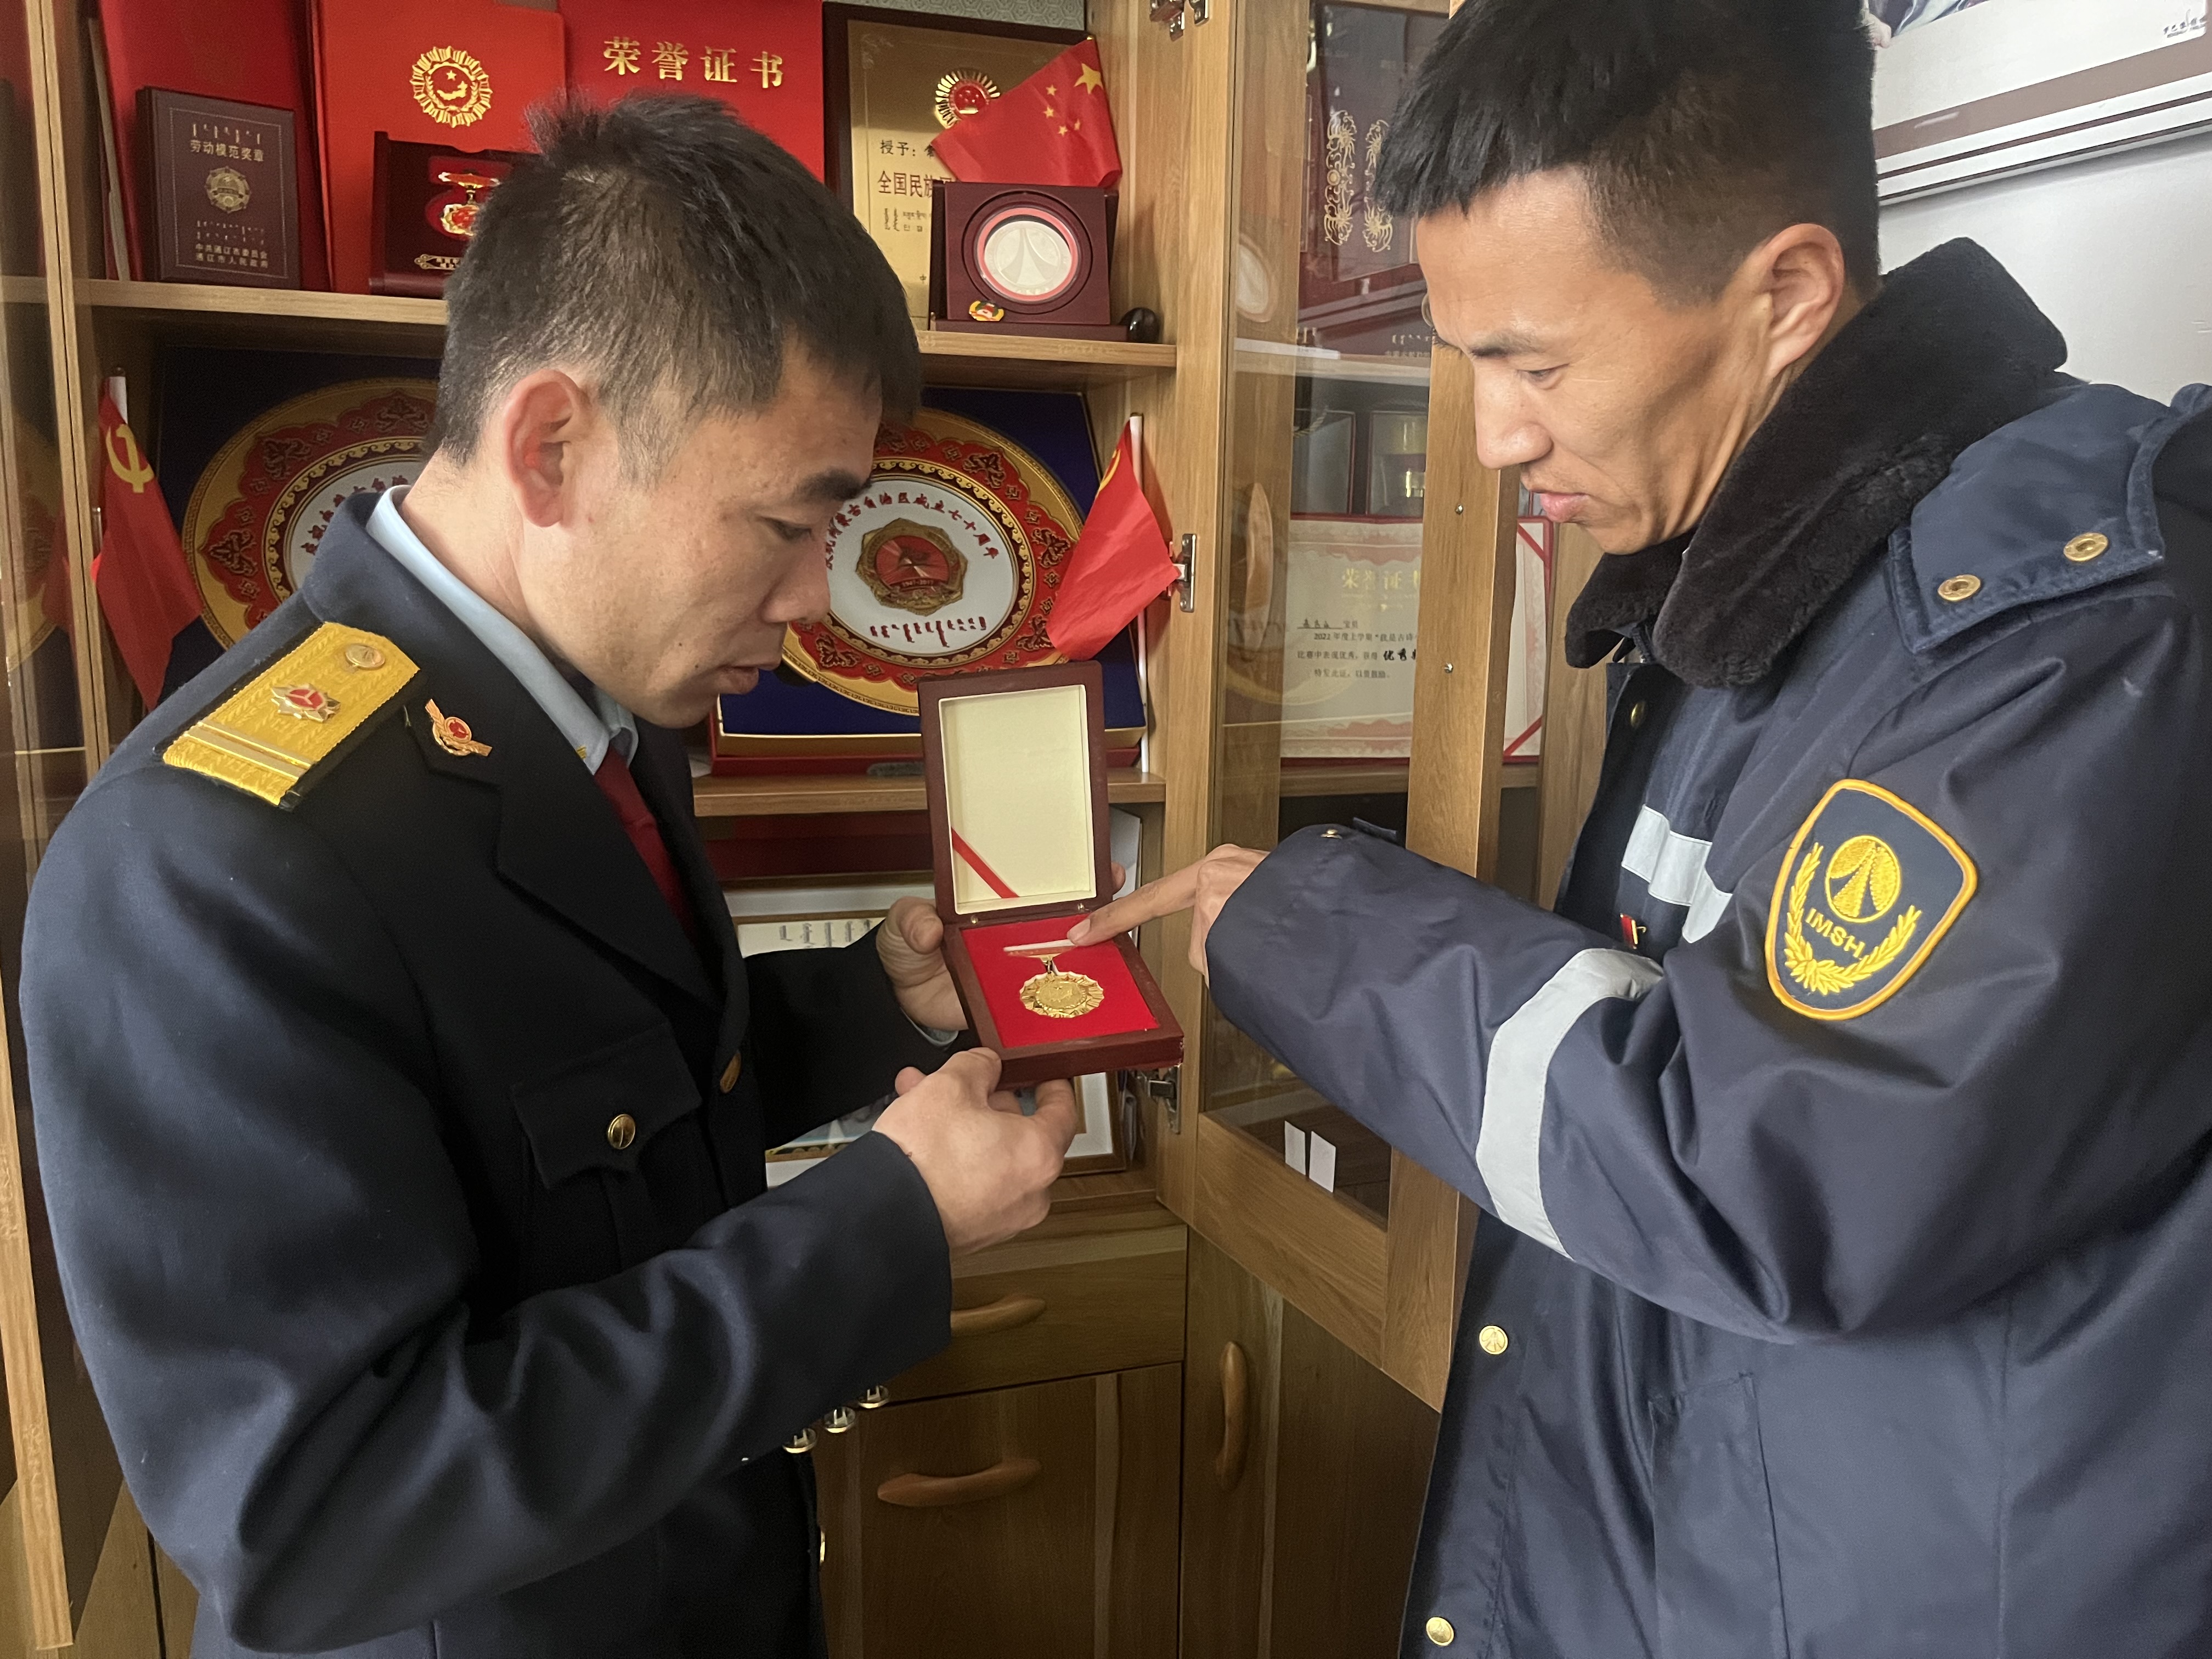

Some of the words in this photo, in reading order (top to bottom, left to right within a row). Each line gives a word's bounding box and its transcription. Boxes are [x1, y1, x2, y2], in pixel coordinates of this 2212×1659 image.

[603, 36, 783, 88] 荣誉证书
[191, 139, 263, 161] 劳动模范奖章
[878, 171, 952, 198] 全国民族
[1805, 907, 1865, 958] IMSH
